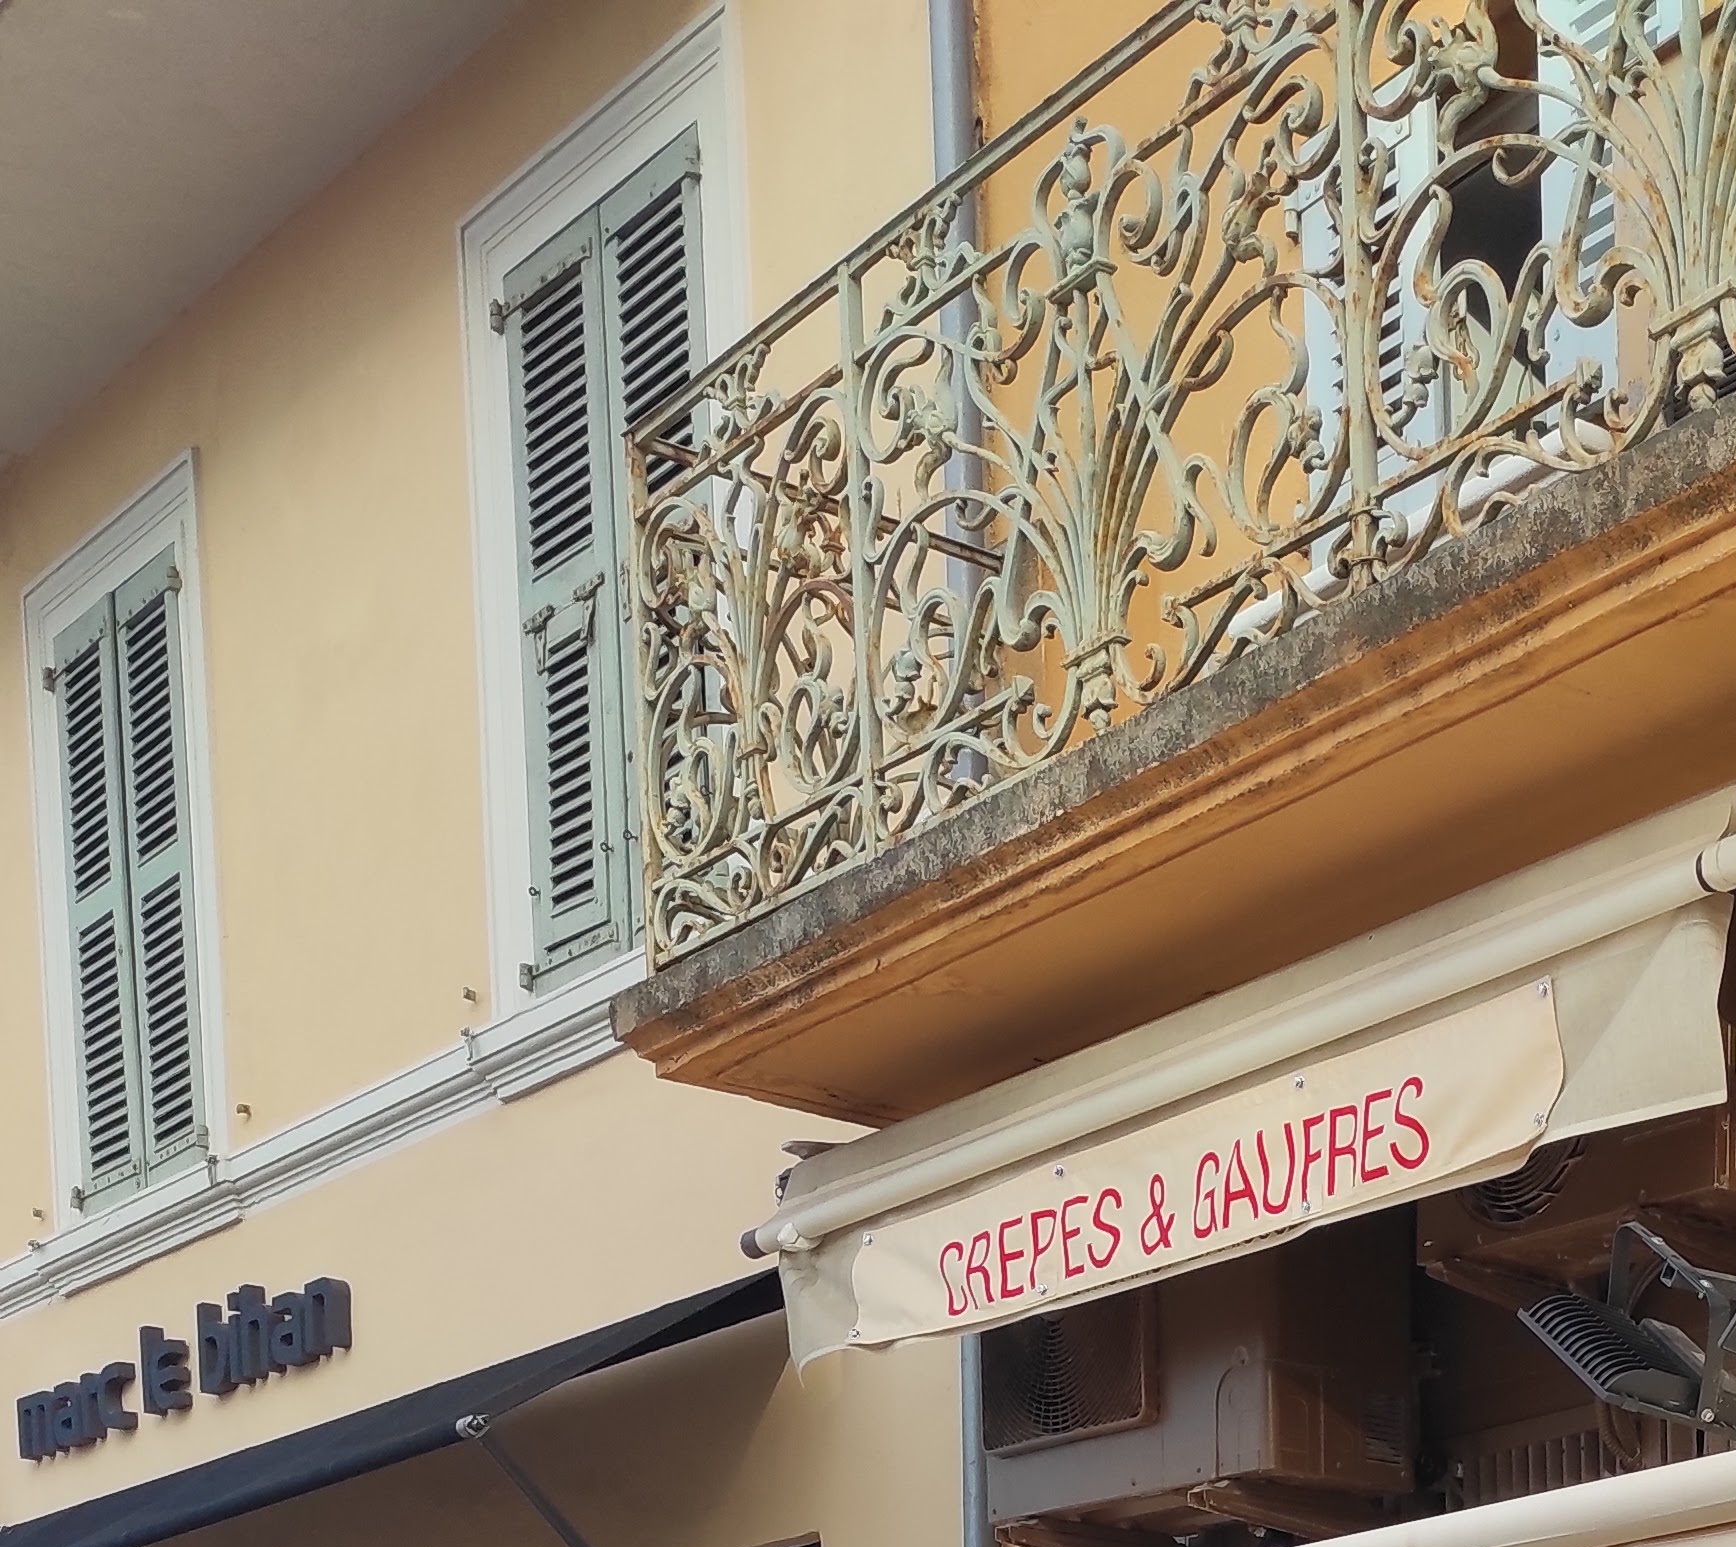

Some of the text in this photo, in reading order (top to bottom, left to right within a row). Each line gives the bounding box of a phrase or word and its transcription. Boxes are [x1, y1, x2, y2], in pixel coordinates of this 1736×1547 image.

[939, 1076, 1430, 1316] CREPES & GAUFRES
[17, 1362, 138, 1461] marc
